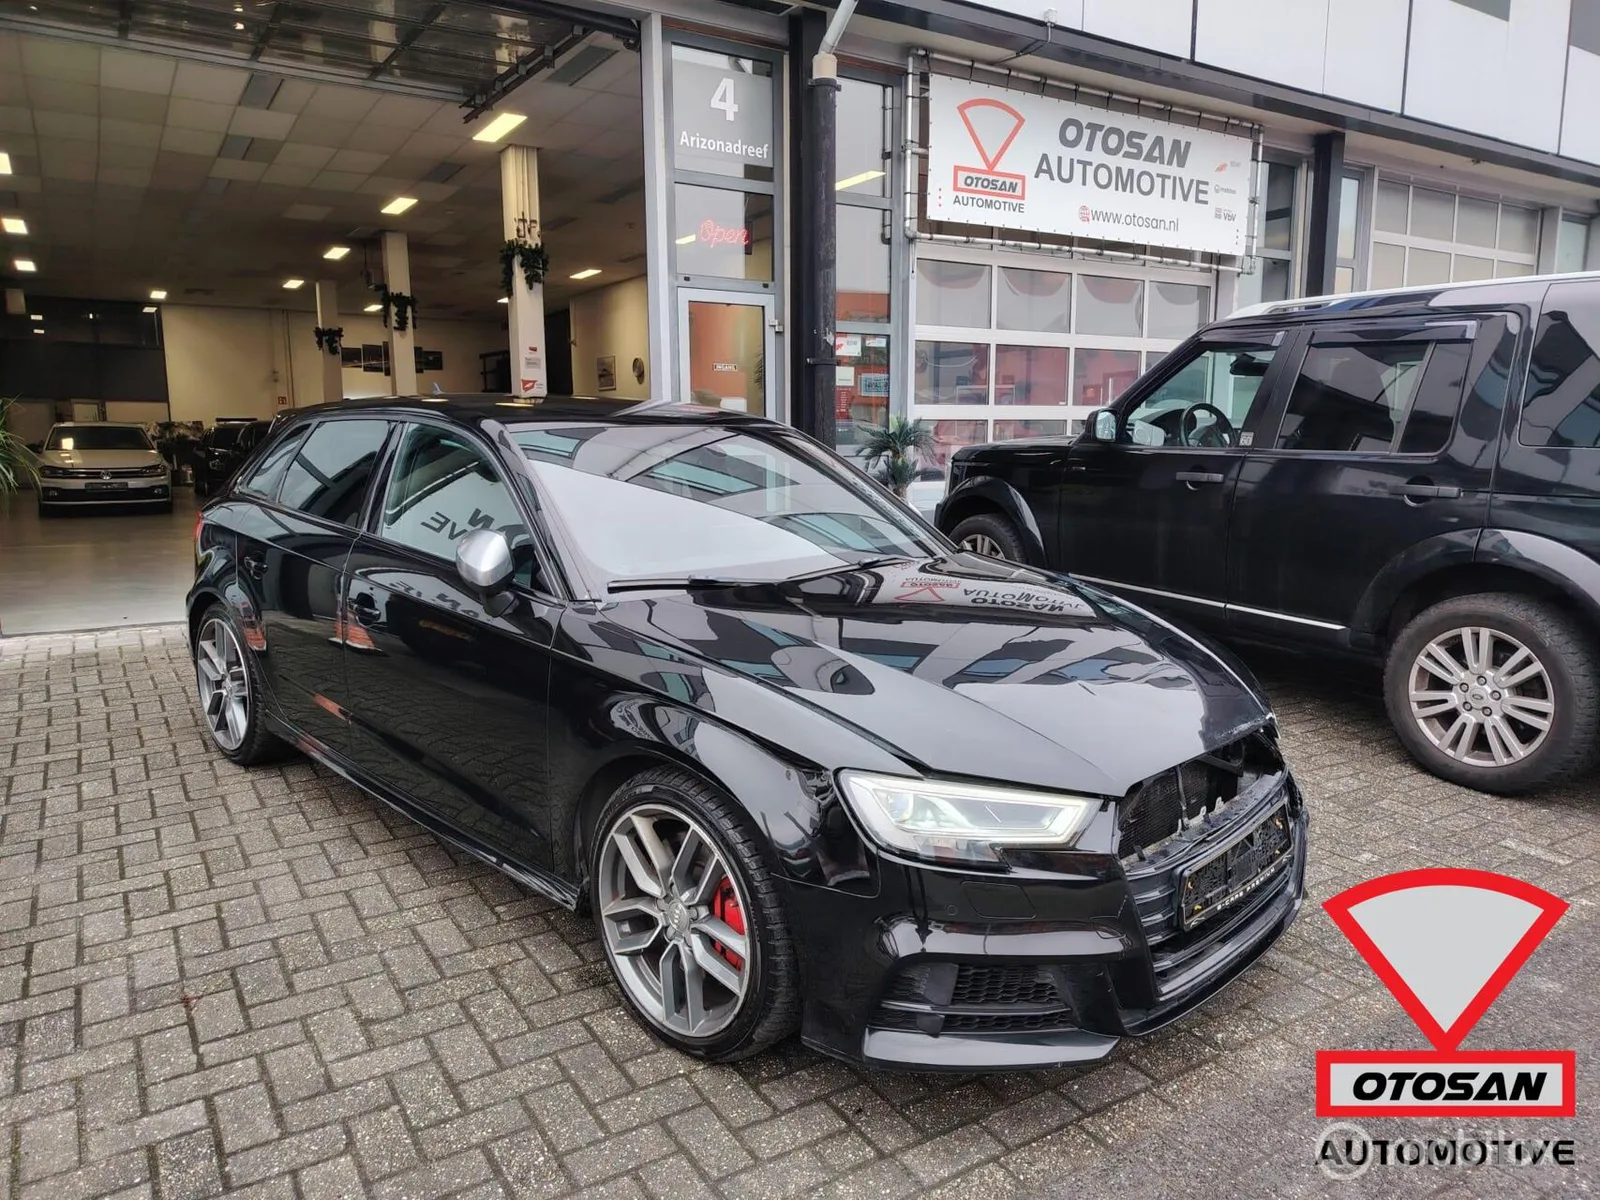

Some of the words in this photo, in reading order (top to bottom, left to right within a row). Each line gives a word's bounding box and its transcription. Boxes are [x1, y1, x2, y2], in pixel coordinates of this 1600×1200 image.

[710, 77, 739, 122] 4
[679, 130, 769, 159] Arizonadreef
[1058, 117, 1192, 168] OTOSAN
[963, 175, 1019, 193] OTOSAN
[1034, 153, 1210, 205] AUTOMOTIVE
[952, 194, 1025, 214] AUTOMOTIVE
[700, 219, 749, 248] Open
[1090, 209, 1179, 232] www.otosan.nl
